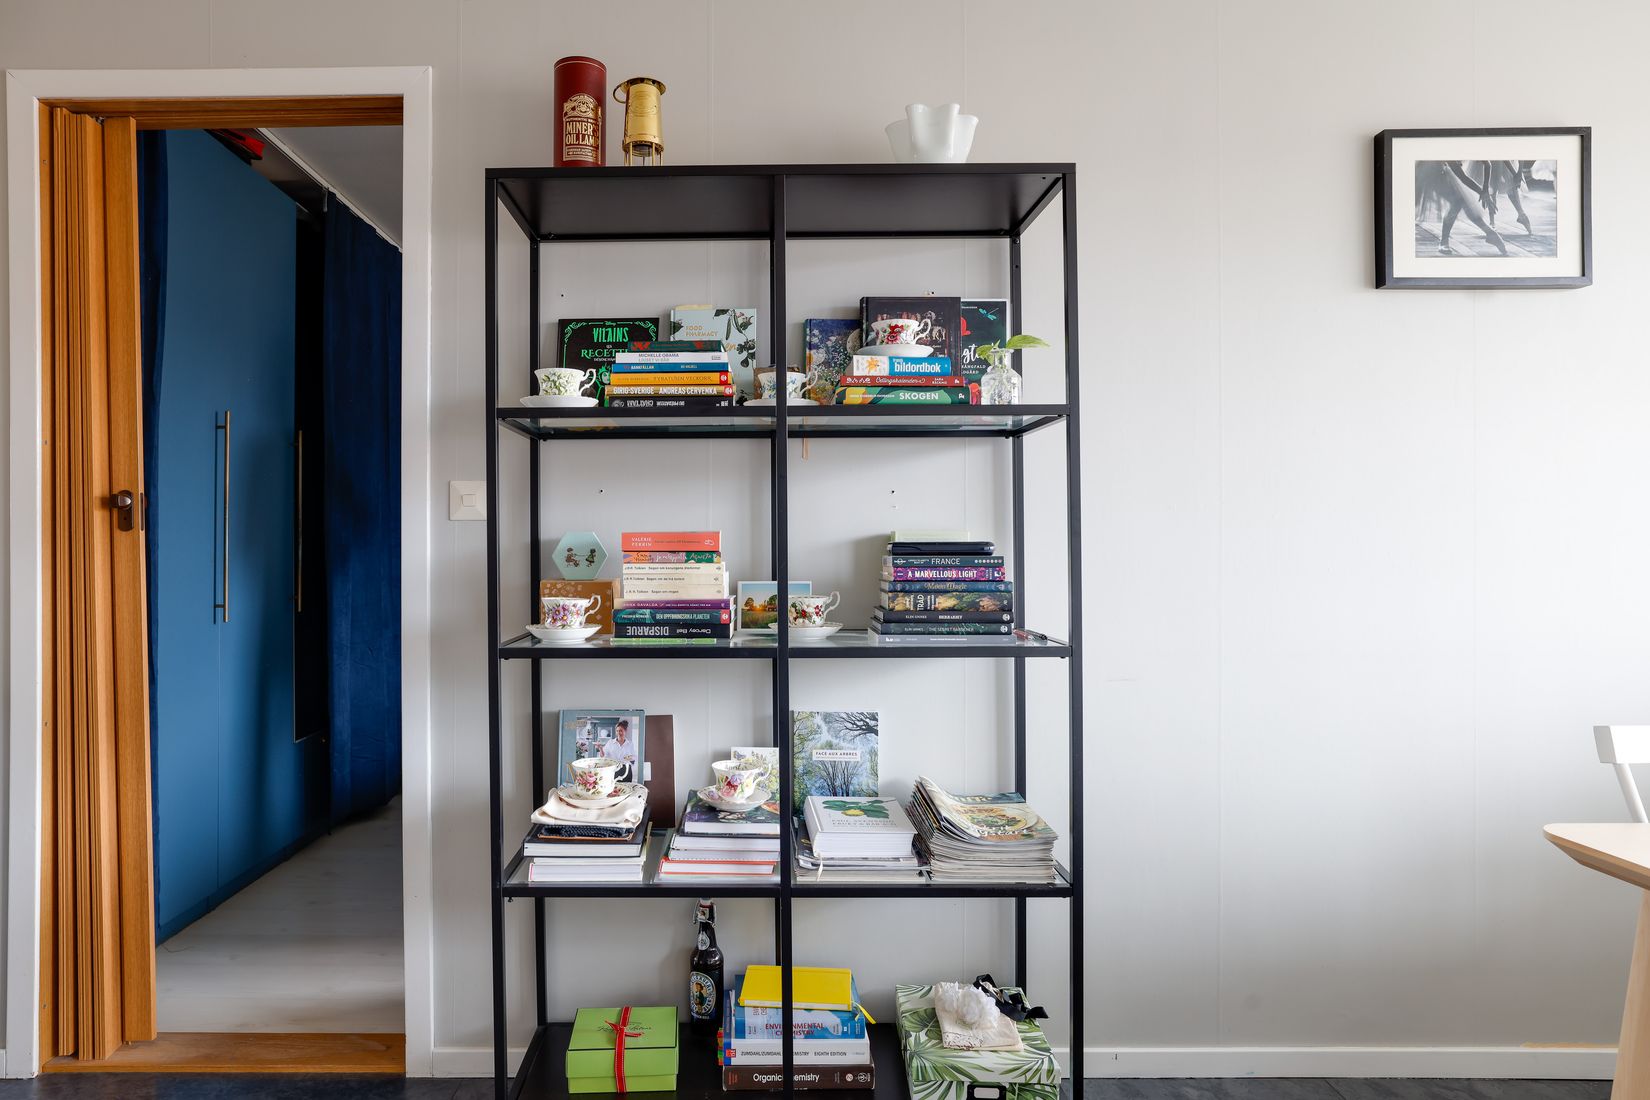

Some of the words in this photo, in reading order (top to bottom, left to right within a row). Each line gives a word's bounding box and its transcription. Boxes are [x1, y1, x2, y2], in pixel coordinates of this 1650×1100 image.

[565, 133, 579, 145] OIL
[592, 327, 629, 342] VILAINS
[894, 362, 941, 373] bildordbok
[658, 386, 686, 395] ANDREAS
[686, 386, 717, 395] CERVENKA
[899, 392, 939, 400] SKOGEN
[931, 557, 961, 565] FRANCE
[914, 570, 957, 578] MARVELLOUS
[958, 570, 977, 578] LIGHT
[626, 626, 669, 636] DISPARUE
[753, 1073, 783, 1083] Organic
[793, 1073, 820, 1083] emistry
